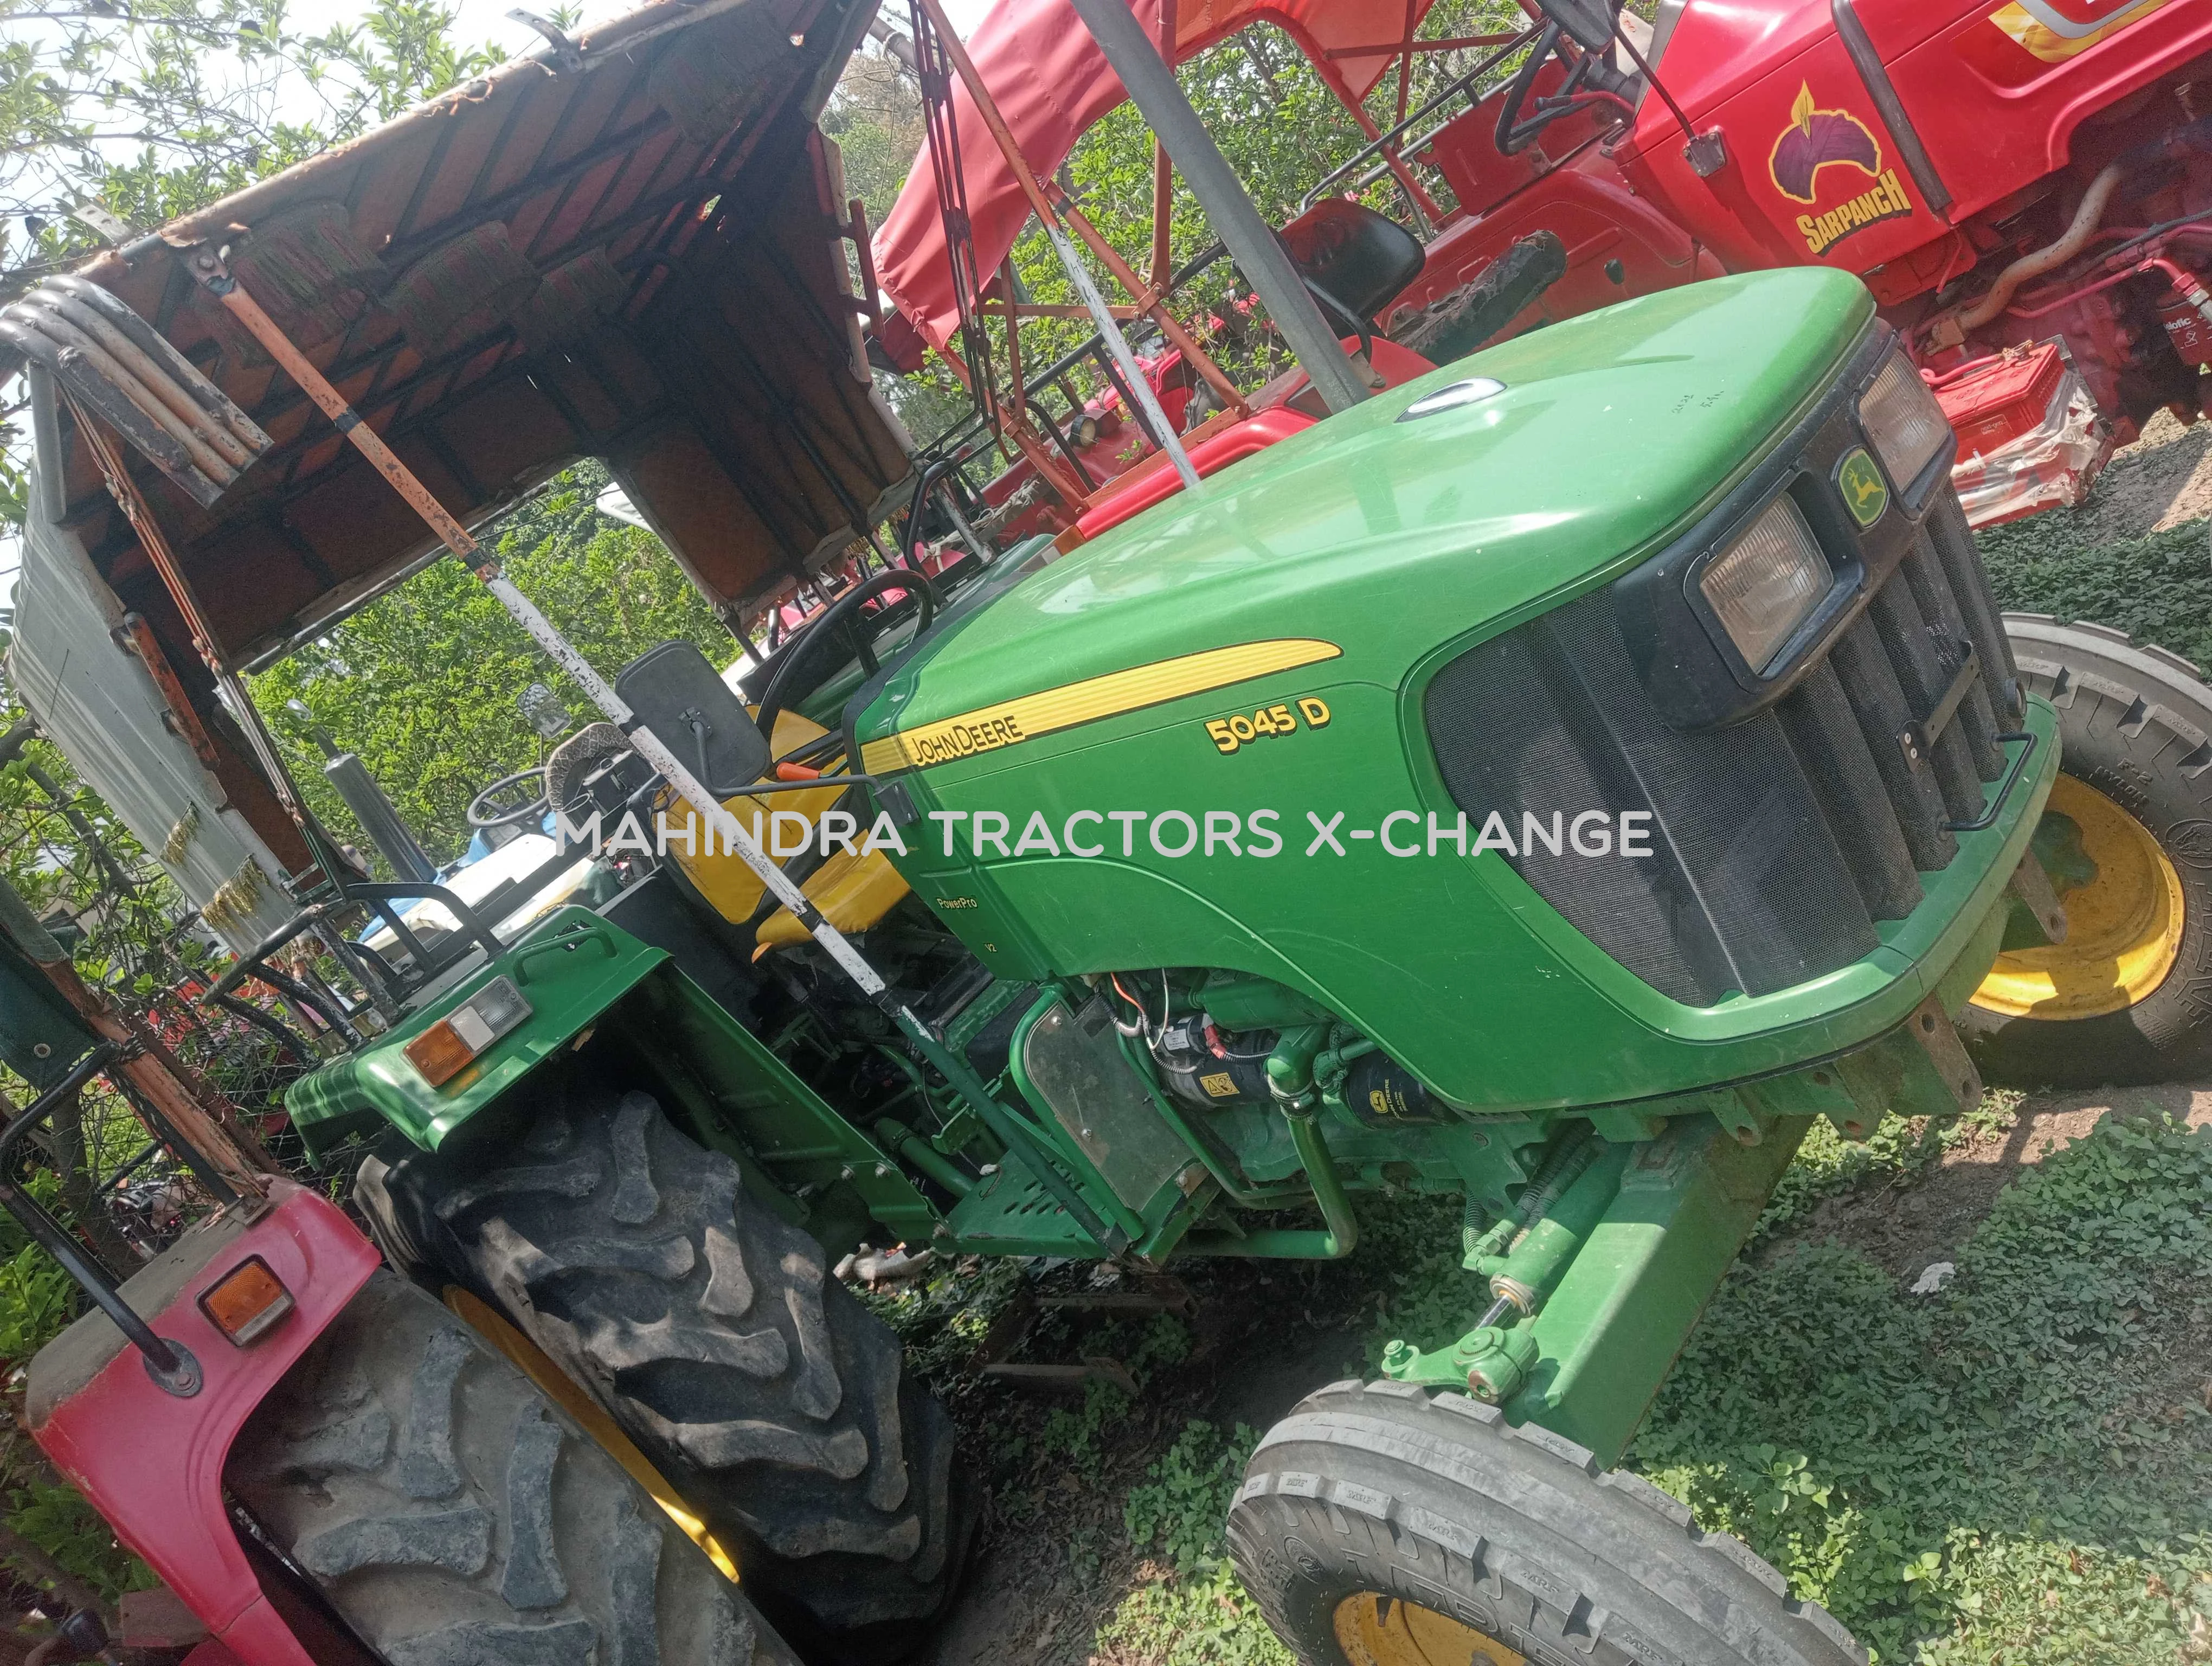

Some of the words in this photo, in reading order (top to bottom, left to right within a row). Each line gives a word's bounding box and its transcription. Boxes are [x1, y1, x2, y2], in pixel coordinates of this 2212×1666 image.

[1796, 168, 1912, 255] SARPANCH
[1204, 703, 1297, 755] 5045
[1295, 697, 1331, 731] D
[936, 897, 978, 909] PowerPro
